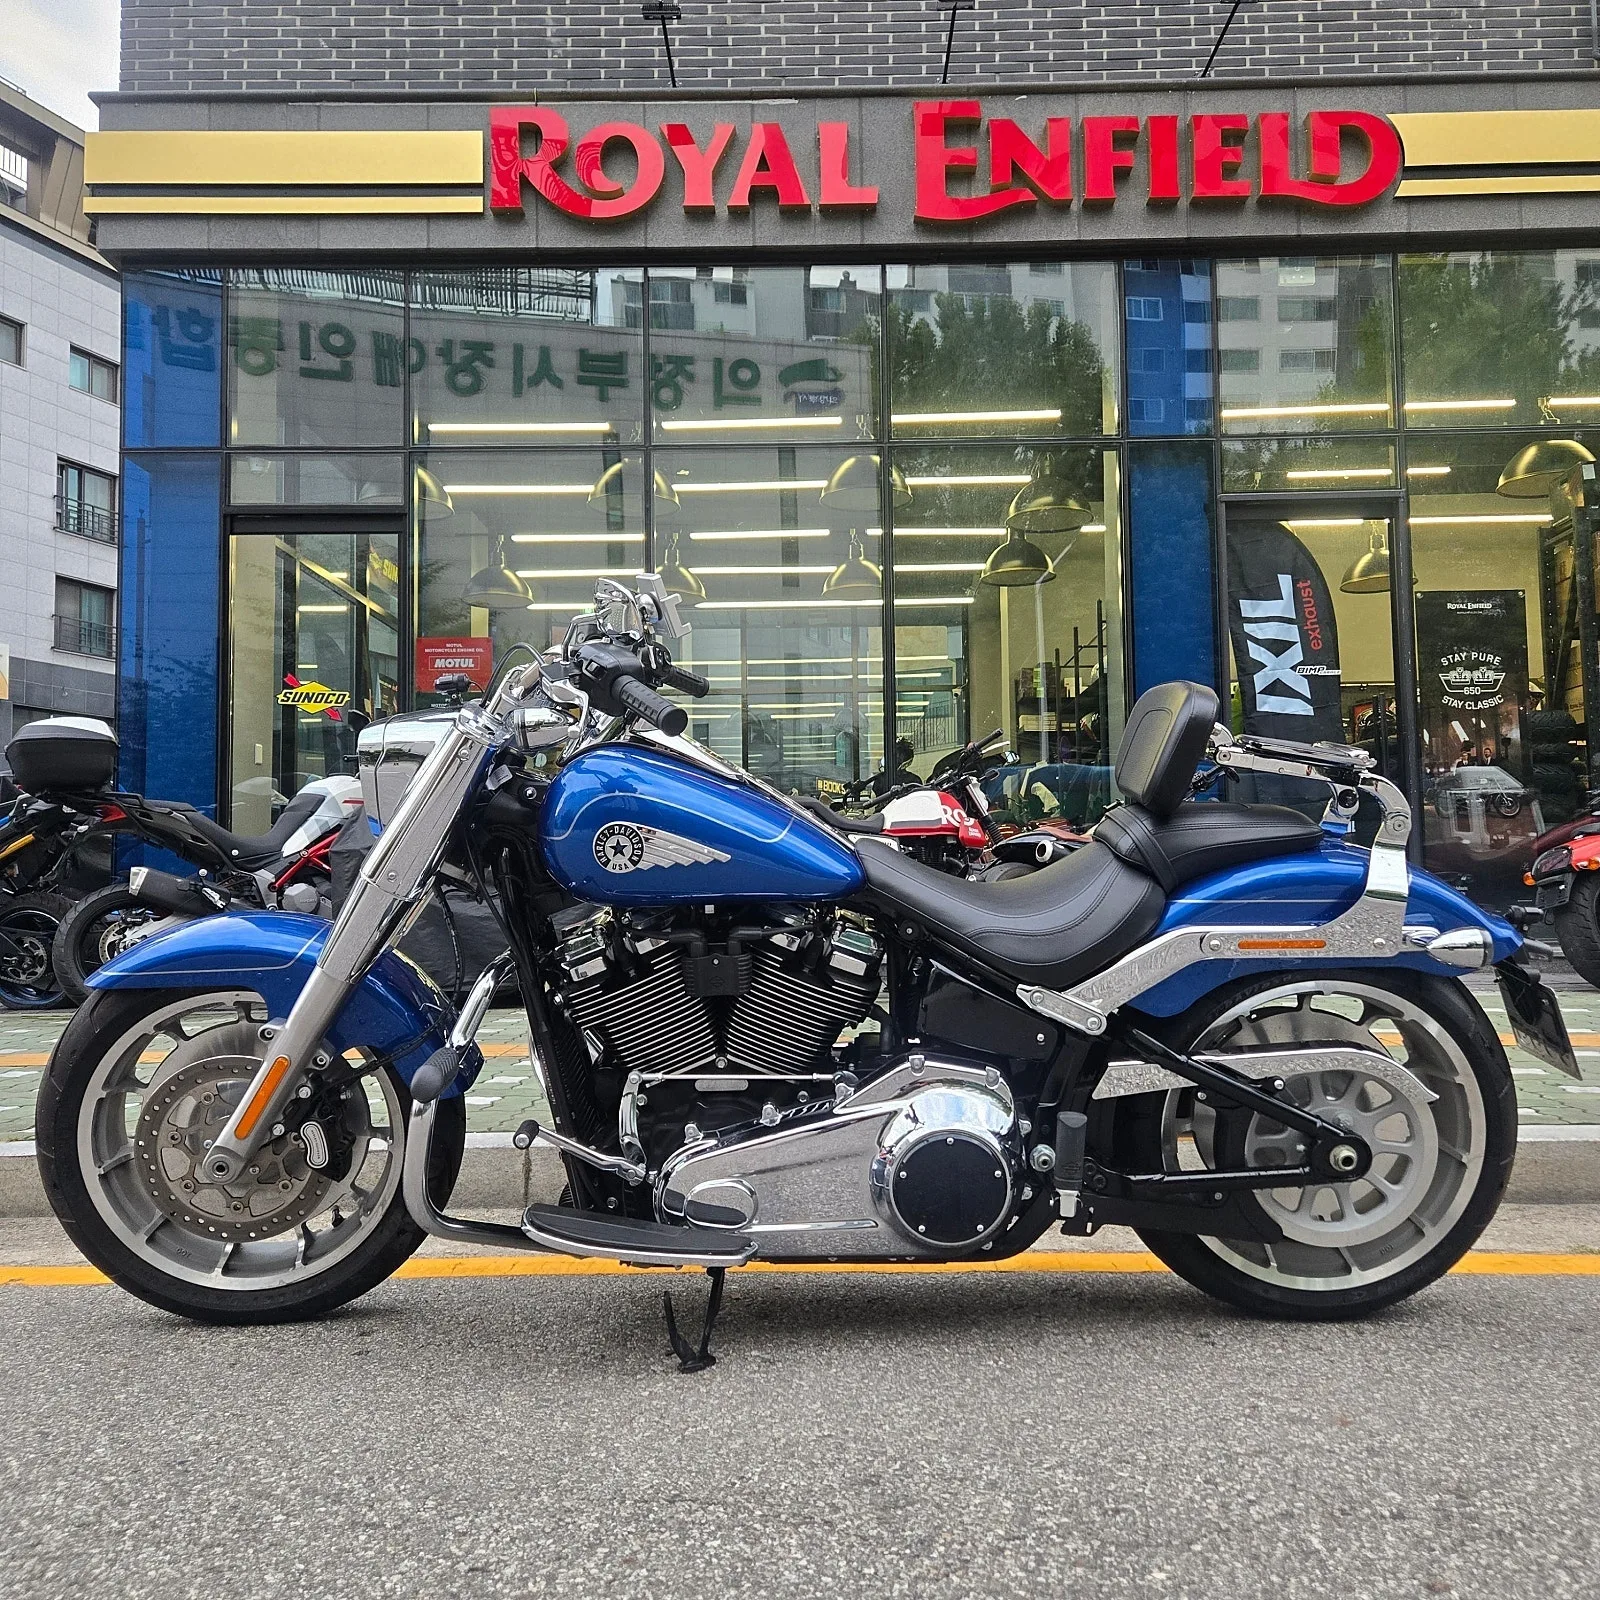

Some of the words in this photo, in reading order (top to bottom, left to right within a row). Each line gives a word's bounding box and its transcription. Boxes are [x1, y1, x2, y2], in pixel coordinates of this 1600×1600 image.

[489, 106, 880, 220] ROYAL
[913, 100, 1404, 222] ENFIELD
[1446, 602, 1467, 610] ROYAL
[1467, 602, 1493, 610] ENFIELD
[1296, 578, 1322, 651] exhaust
[434, 658, 475, 668] MOTUL
[1440, 652, 1467, 666] STAY
[1471, 652, 1502, 666] PURE
[279, 690, 350, 706] SUNOCO
[1463, 686, 1481, 695] 650
[1441, 695, 1464, 709] STAY
[1464, 694, 1505, 710] CLASSIC
[596, 825, 642, 864] HARLEY-DAVIDSON
[612, 863, 629, 871] USA
